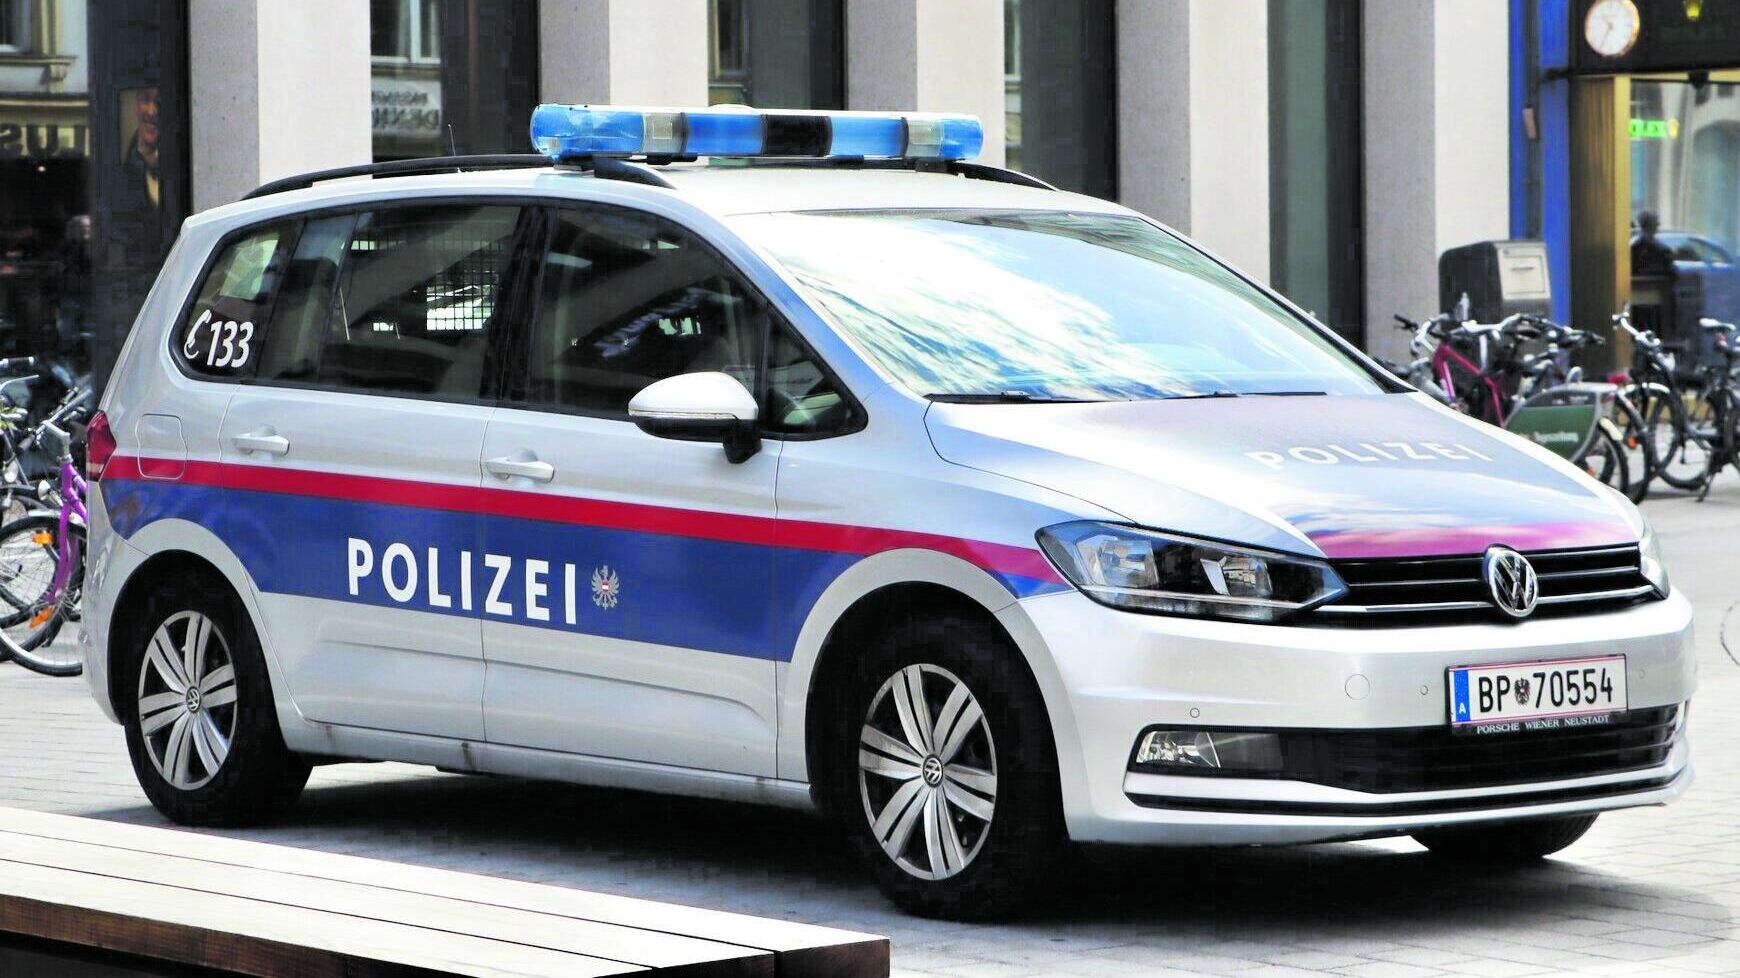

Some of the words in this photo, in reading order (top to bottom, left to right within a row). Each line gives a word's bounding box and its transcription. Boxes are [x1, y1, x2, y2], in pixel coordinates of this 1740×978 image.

[207, 320, 254, 368] 133
[1245, 441, 1495, 471] POLIZEI
[348, 537, 577, 625] POLIZEI
[1458, 702, 1468, 715] A
[1478, 675, 1511, 713] BP
[1532, 667, 1613, 709] 70554
[1476, 722, 1520, 735] PORSCHE
[1525, 719, 1560, 730] WIENER
[1564, 714, 1610, 727] NEUSTADT
